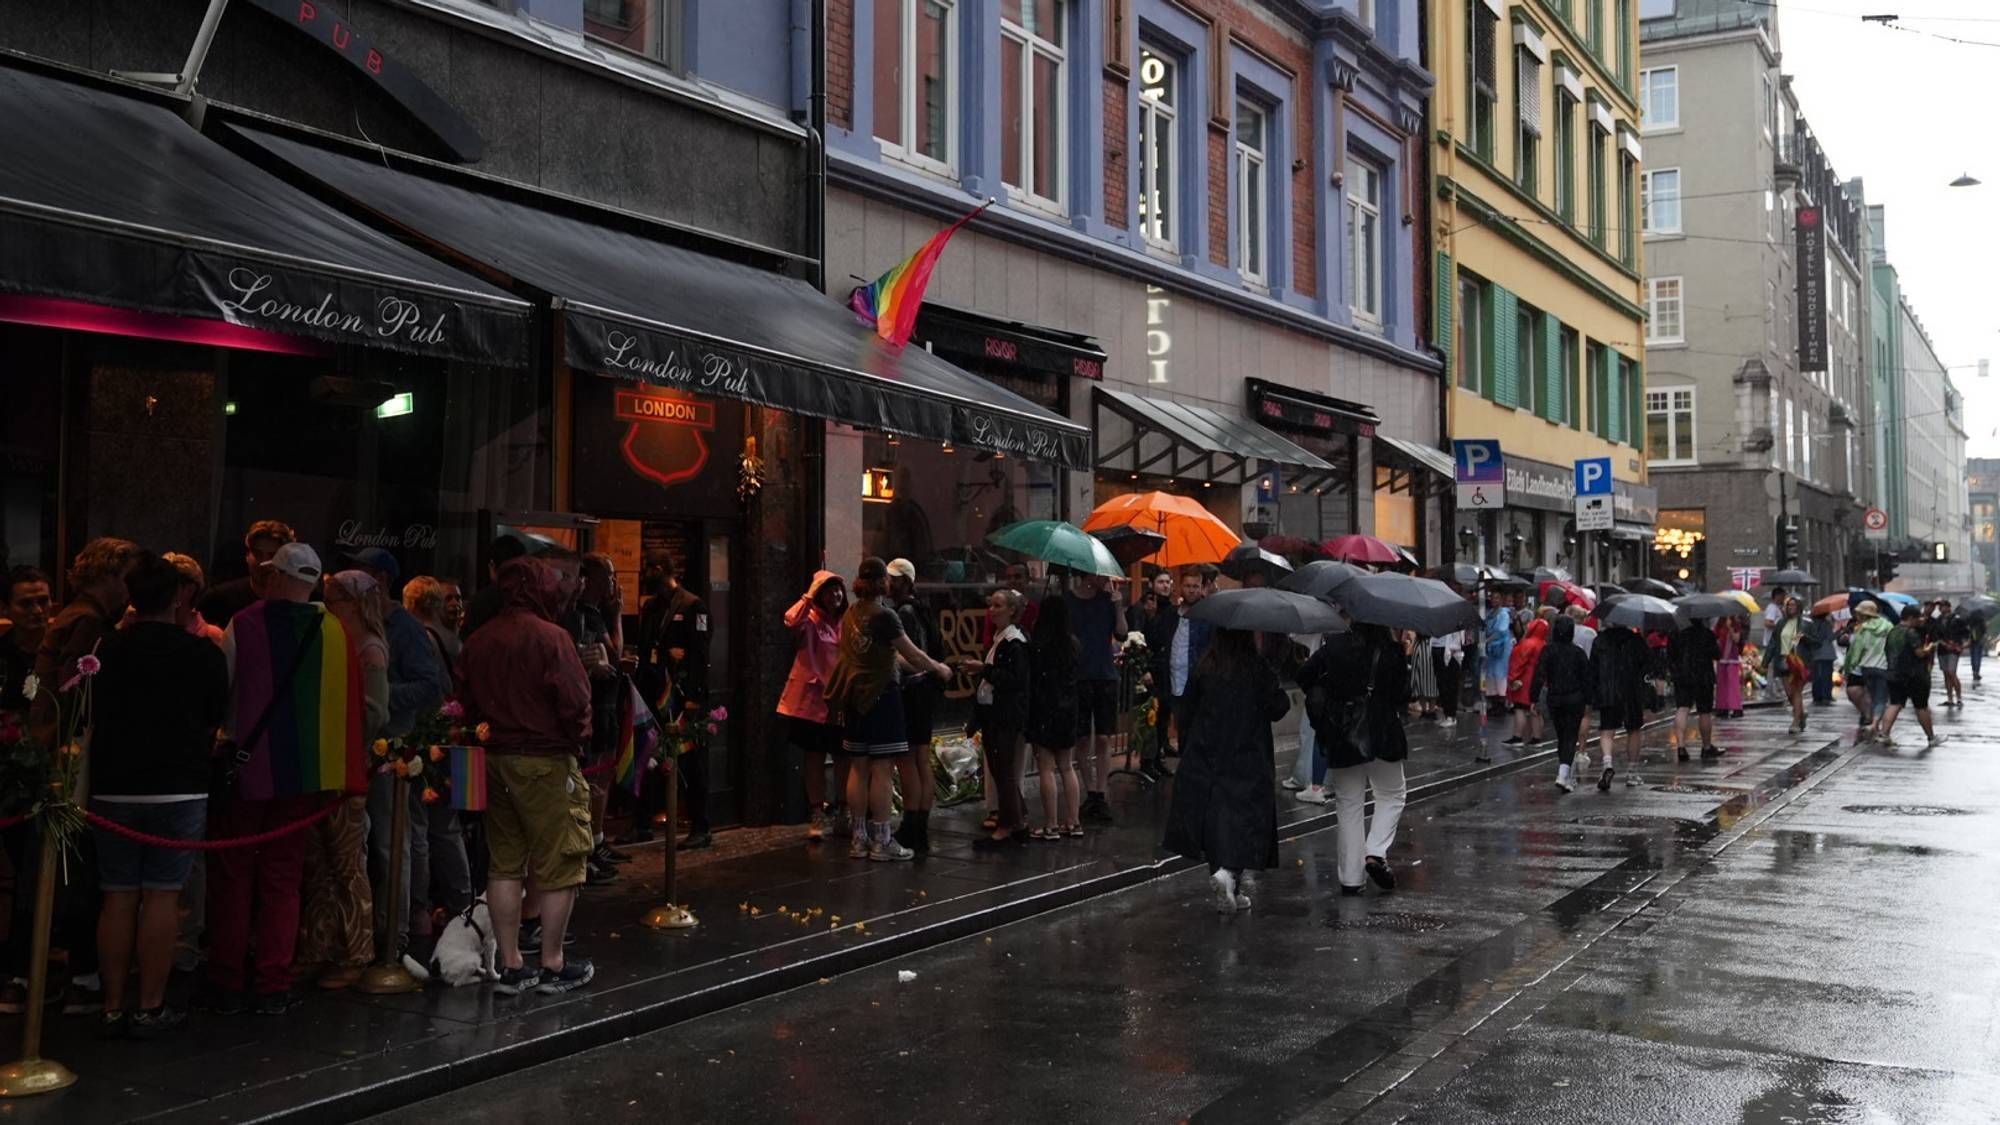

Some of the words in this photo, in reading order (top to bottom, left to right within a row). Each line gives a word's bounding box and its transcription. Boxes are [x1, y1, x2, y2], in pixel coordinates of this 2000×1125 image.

[299, 3, 384, 75] PUB
[1806, 231, 1816, 277] HOTELL
[222, 267, 364, 334] London
[376, 296, 446, 346] Pub
[1807, 280, 1819, 364] BONDEHEIMEN
[603, 330, 694, 383] London
[700, 352, 749, 394] Pub
[634, 400, 696, 421] LONDON
[972, 416, 1026, 451] London
[1031, 429, 1060, 459] Pub
[1465, 444, 1490, 477] P
[1583, 463, 1602, 492] P
[335, 519, 400, 547] London
[403, 523, 438, 550] Pub
